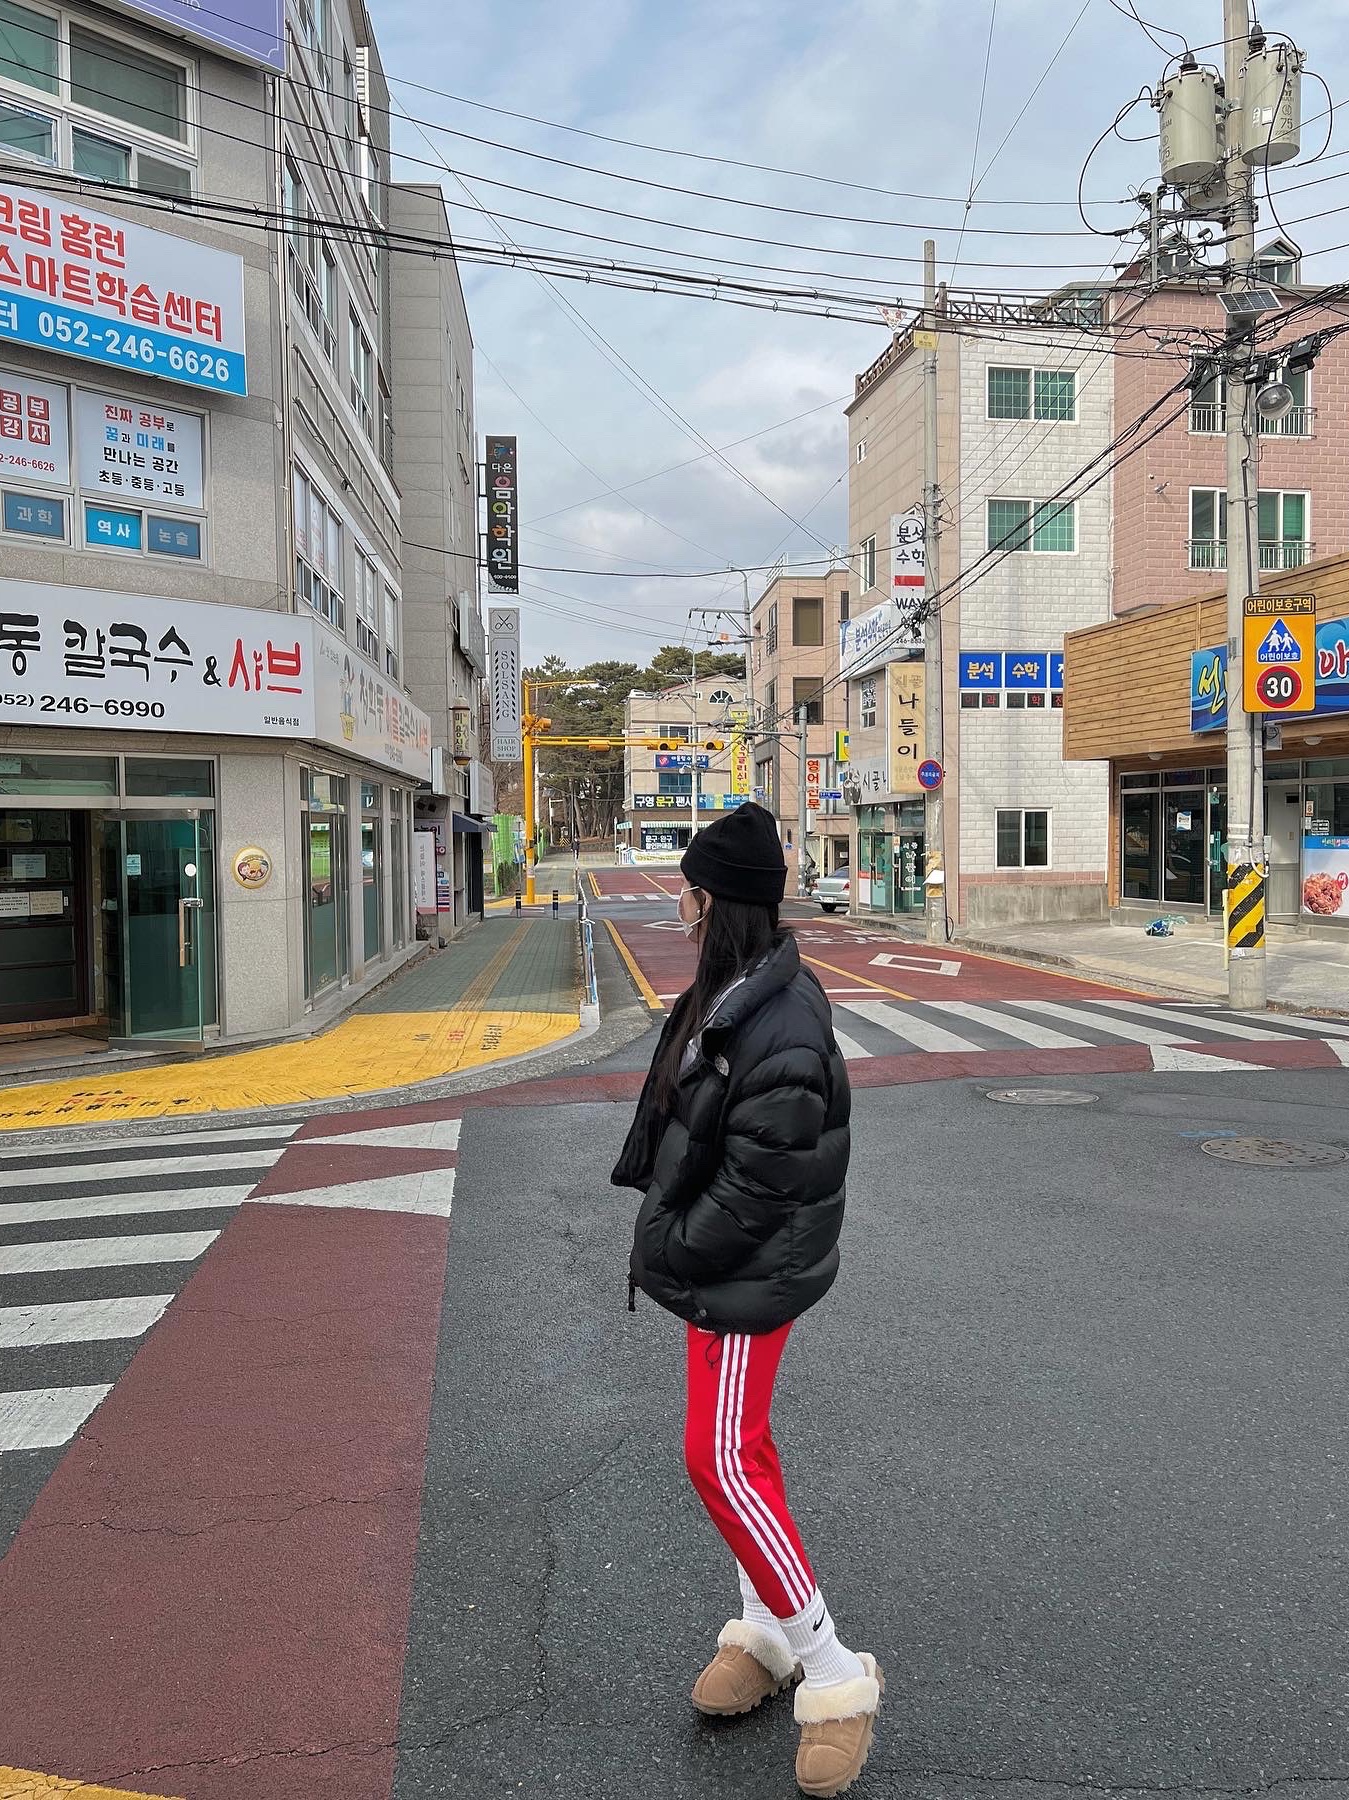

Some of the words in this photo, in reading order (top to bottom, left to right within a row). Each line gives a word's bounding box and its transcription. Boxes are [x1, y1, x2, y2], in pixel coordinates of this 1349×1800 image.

[60, 213, 127, 269] 홈런
[0, 243, 223, 343] 스마트학습센터
[38, 310, 230, 382] 052-246-6626
[104, 404, 134, 424] 진짜
[138, 411, 175, 432] 공부로
[103, 446, 147, 469] 만나는
[152, 455, 179, 475] 공간
[16, 505, 53, 526] 과학
[492, 476, 515, 570] 음악학원
[97, 519, 131, 539] 역사
[158, 528, 189, 547] 논술
[896, 548, 926, 568] 수학
[1247, 598, 1312, 613] 어린이보호구역
[63, 619, 194, 683] 칼국수
[202, 655, 222, 688] &
[228, 638, 303, 695] 샤브
[1260, 653, 1299, 662] 어린이보호
[967, 661, 994, 680] 분석
[1012, 661, 1040, 680] 수학
[501, 650, 511, 719] SOLSANG
[1266, 676, 1293, 699] 30
[39, 694, 166, 720] 246-6990
[263, 715, 300, 727] 일반음식점
[897, 692, 920, 760] 나들이
[636, 796, 655, 807] 구영
[656, 796, 674, 807] 문구
